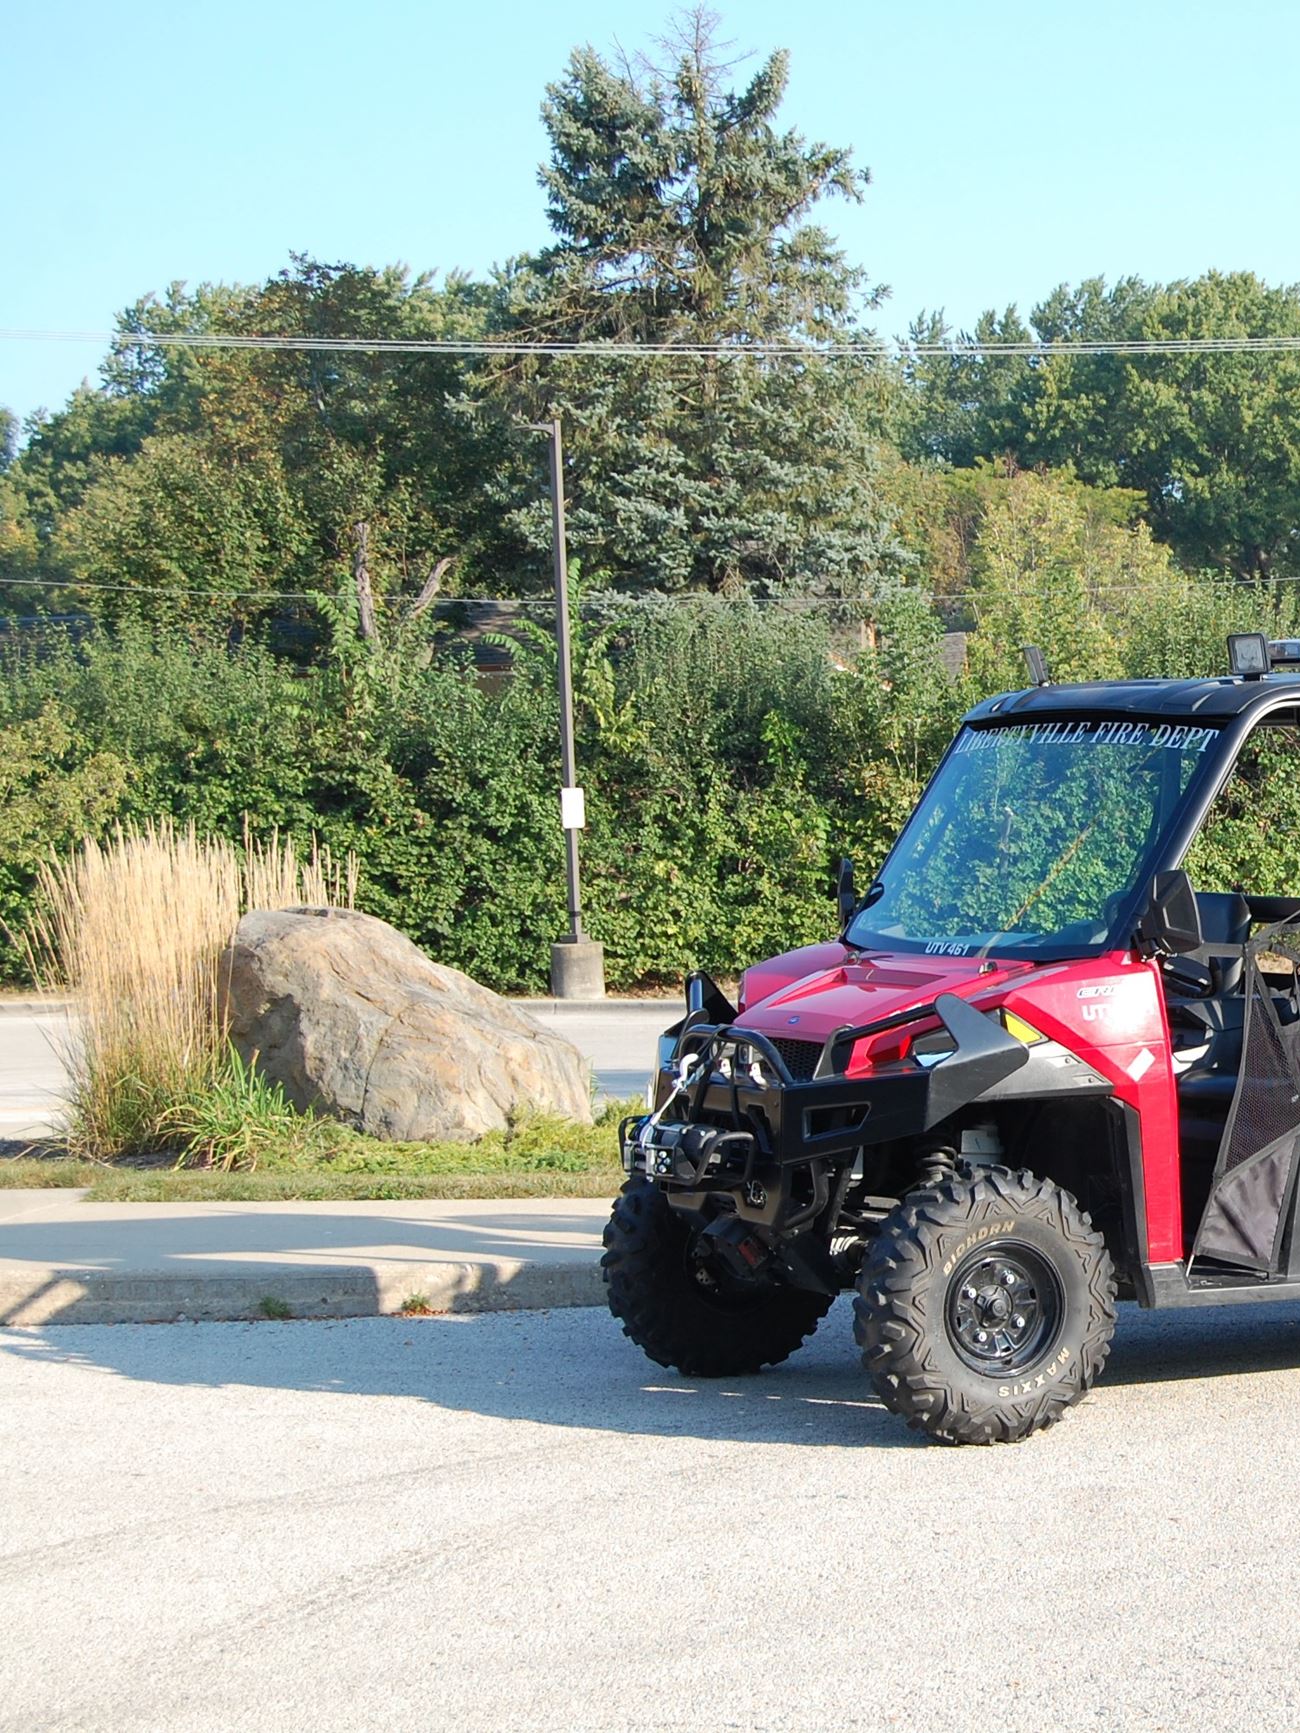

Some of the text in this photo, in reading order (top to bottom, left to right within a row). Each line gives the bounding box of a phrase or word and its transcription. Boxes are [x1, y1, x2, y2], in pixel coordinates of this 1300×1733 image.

[953, 721, 1221, 755] LIBERTYVILLE FIRE DEPT
[924, 941, 971, 956] UTV 461
[998, 1346, 1070, 1398] MAXXIS
